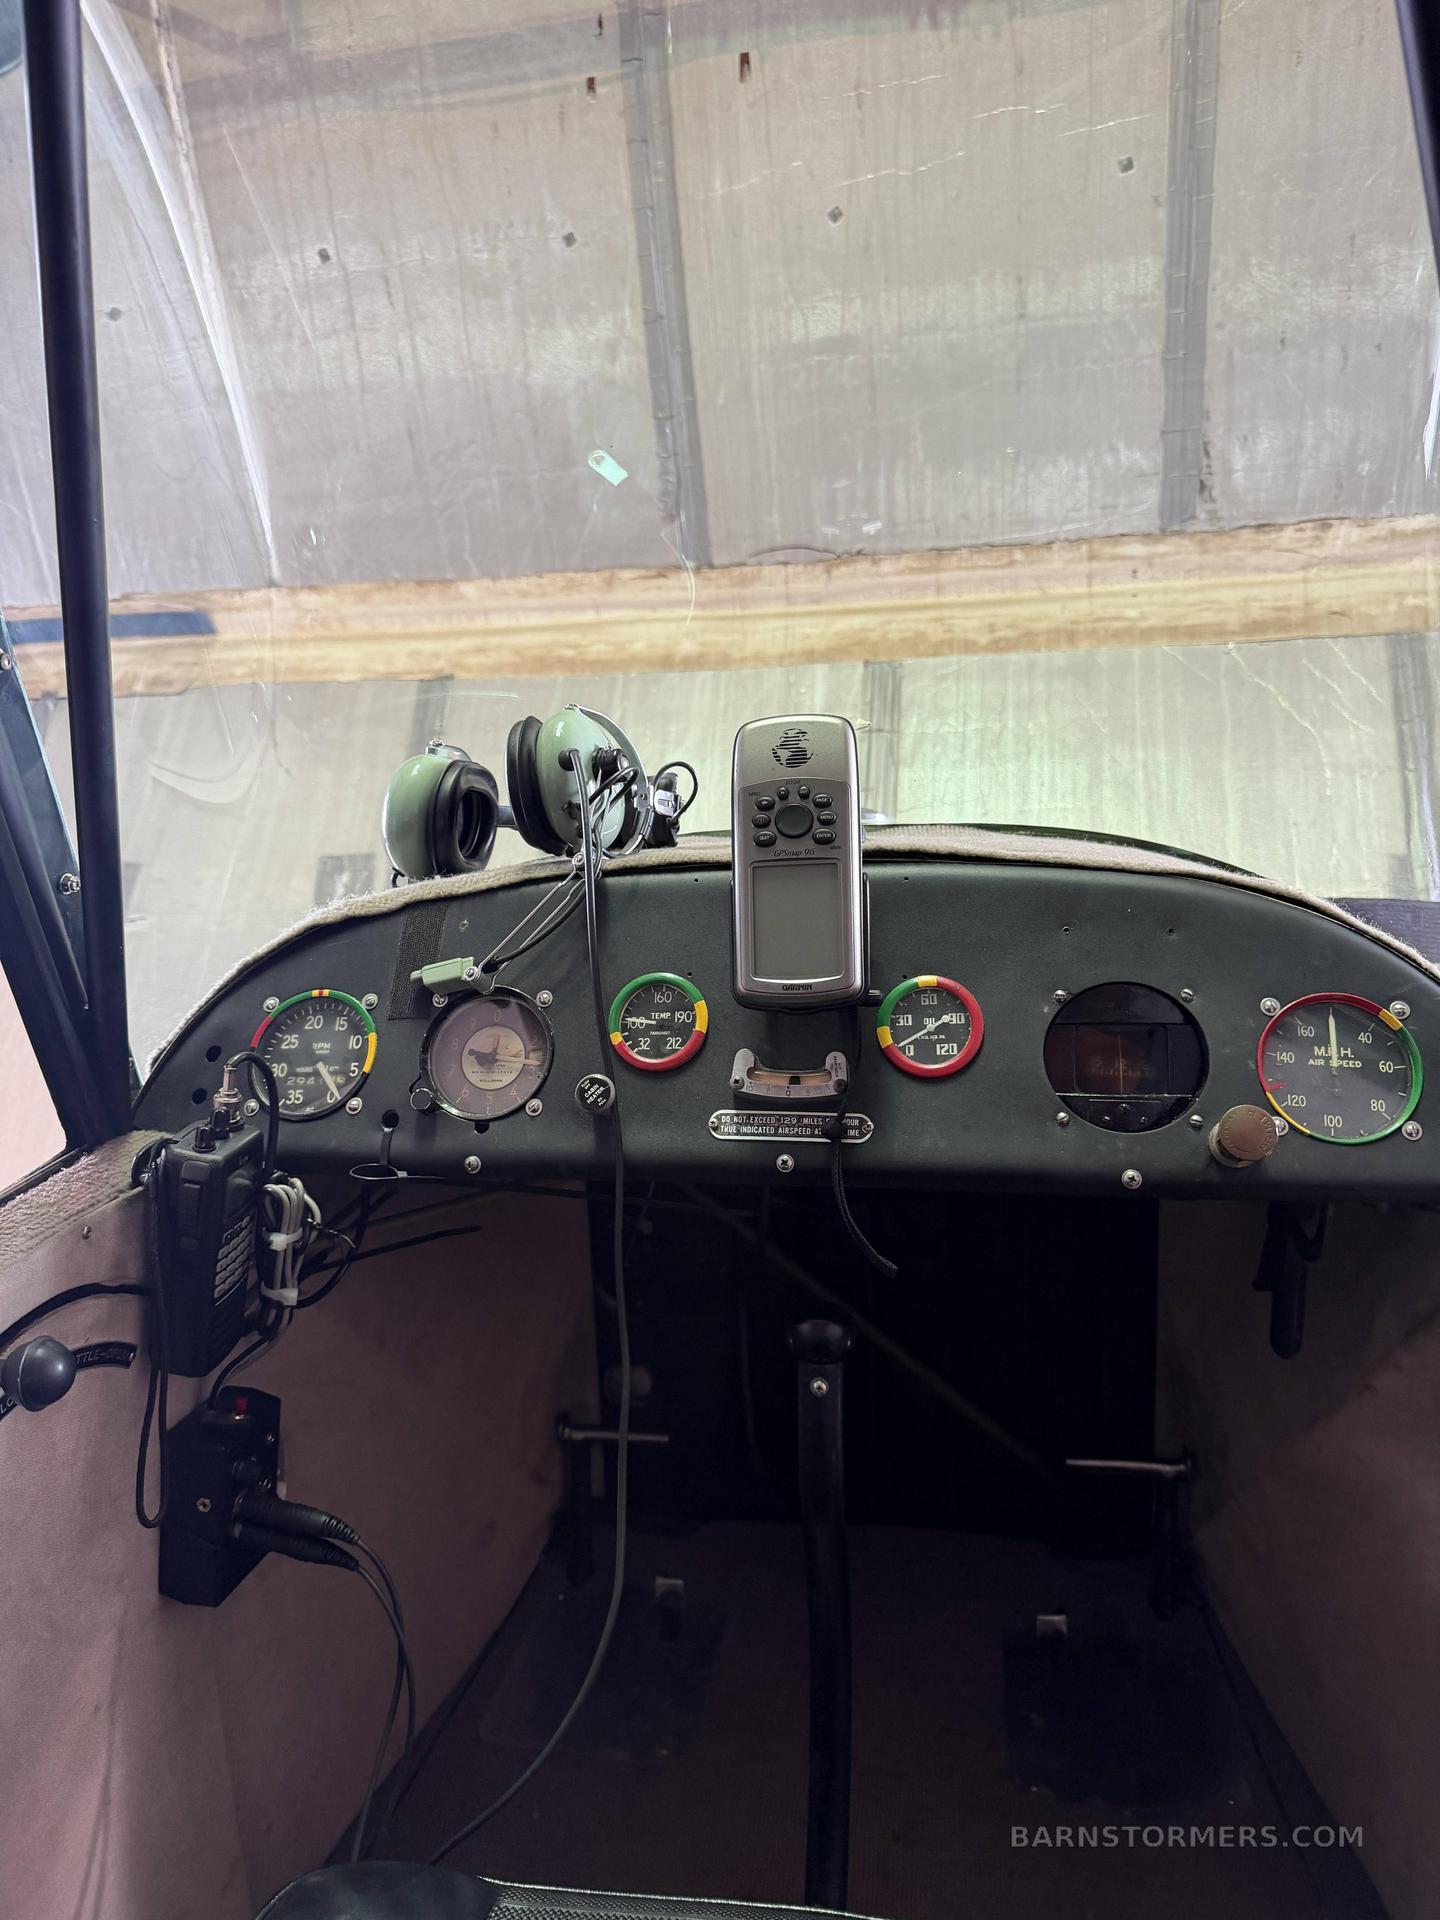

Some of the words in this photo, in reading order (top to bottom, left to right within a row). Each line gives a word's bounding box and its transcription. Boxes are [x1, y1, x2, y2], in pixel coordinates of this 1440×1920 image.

[773, 849, 802, 857] GPSmap
[654, 991, 673, 1003] 160
[920, 993, 938, 1005] 60
[304, 1015, 323, 1029] 20
[494, 1010, 502, 1022] 0
[627, 1016, 646, 1029] 100
[674, 1010, 693, 1023] 190
[895, 1014, 912, 1026] 30
[948, 1012, 965, 1024] 90
[335, 1016, 348, 1031] 15
[1297, 1025, 1315, 1037] 160
[280, 1034, 299, 1050] 25
[348, 1035, 363, 1049] 10
[637, 1037, 651, 1050] 32
[665, 1037, 682, 1050] 212
[1358, 1032, 1373, 1044] 40
[905, 1044, 915, 1056] 0
[936, 1043, 958, 1056] 120
[1276, 1051, 1295, 1064] 140
[1308, 1058, 1325, 1066] AIR
[1330, 1059, 1362, 1068] SPEED
[271, 1063, 288, 1077] 30
[349, 1062, 359, 1077] 5
[1379, 1061, 1394, 1073] 60
[286, 1089, 304, 1105] 35
[327, 1090, 337, 1104] 0
[463, 1085, 470, 1098] 6
[511, 1084, 518, 1098] 4
[584, 1083, 600, 1098] CABIN
[586, 1086, 604, 1104] HEATER
[485, 1092, 493, 1105] 5
[1287, 1094, 1307, 1107] 120
[1370, 1099, 1386, 1112] 80
[721, 1115, 731, 1123] DO
[750, 1116, 776, 1124] EXCEED
[803, 1117, 823, 1125] MILES
[1323, 1114, 1343, 1128] 100
[721, 1125, 737, 1133] TRUE
[740, 1126, 775, 1134] INDICATED
[778, 1126, 811, 1135] AIRSPEED
[847, 1129, 860, 1137] IME
